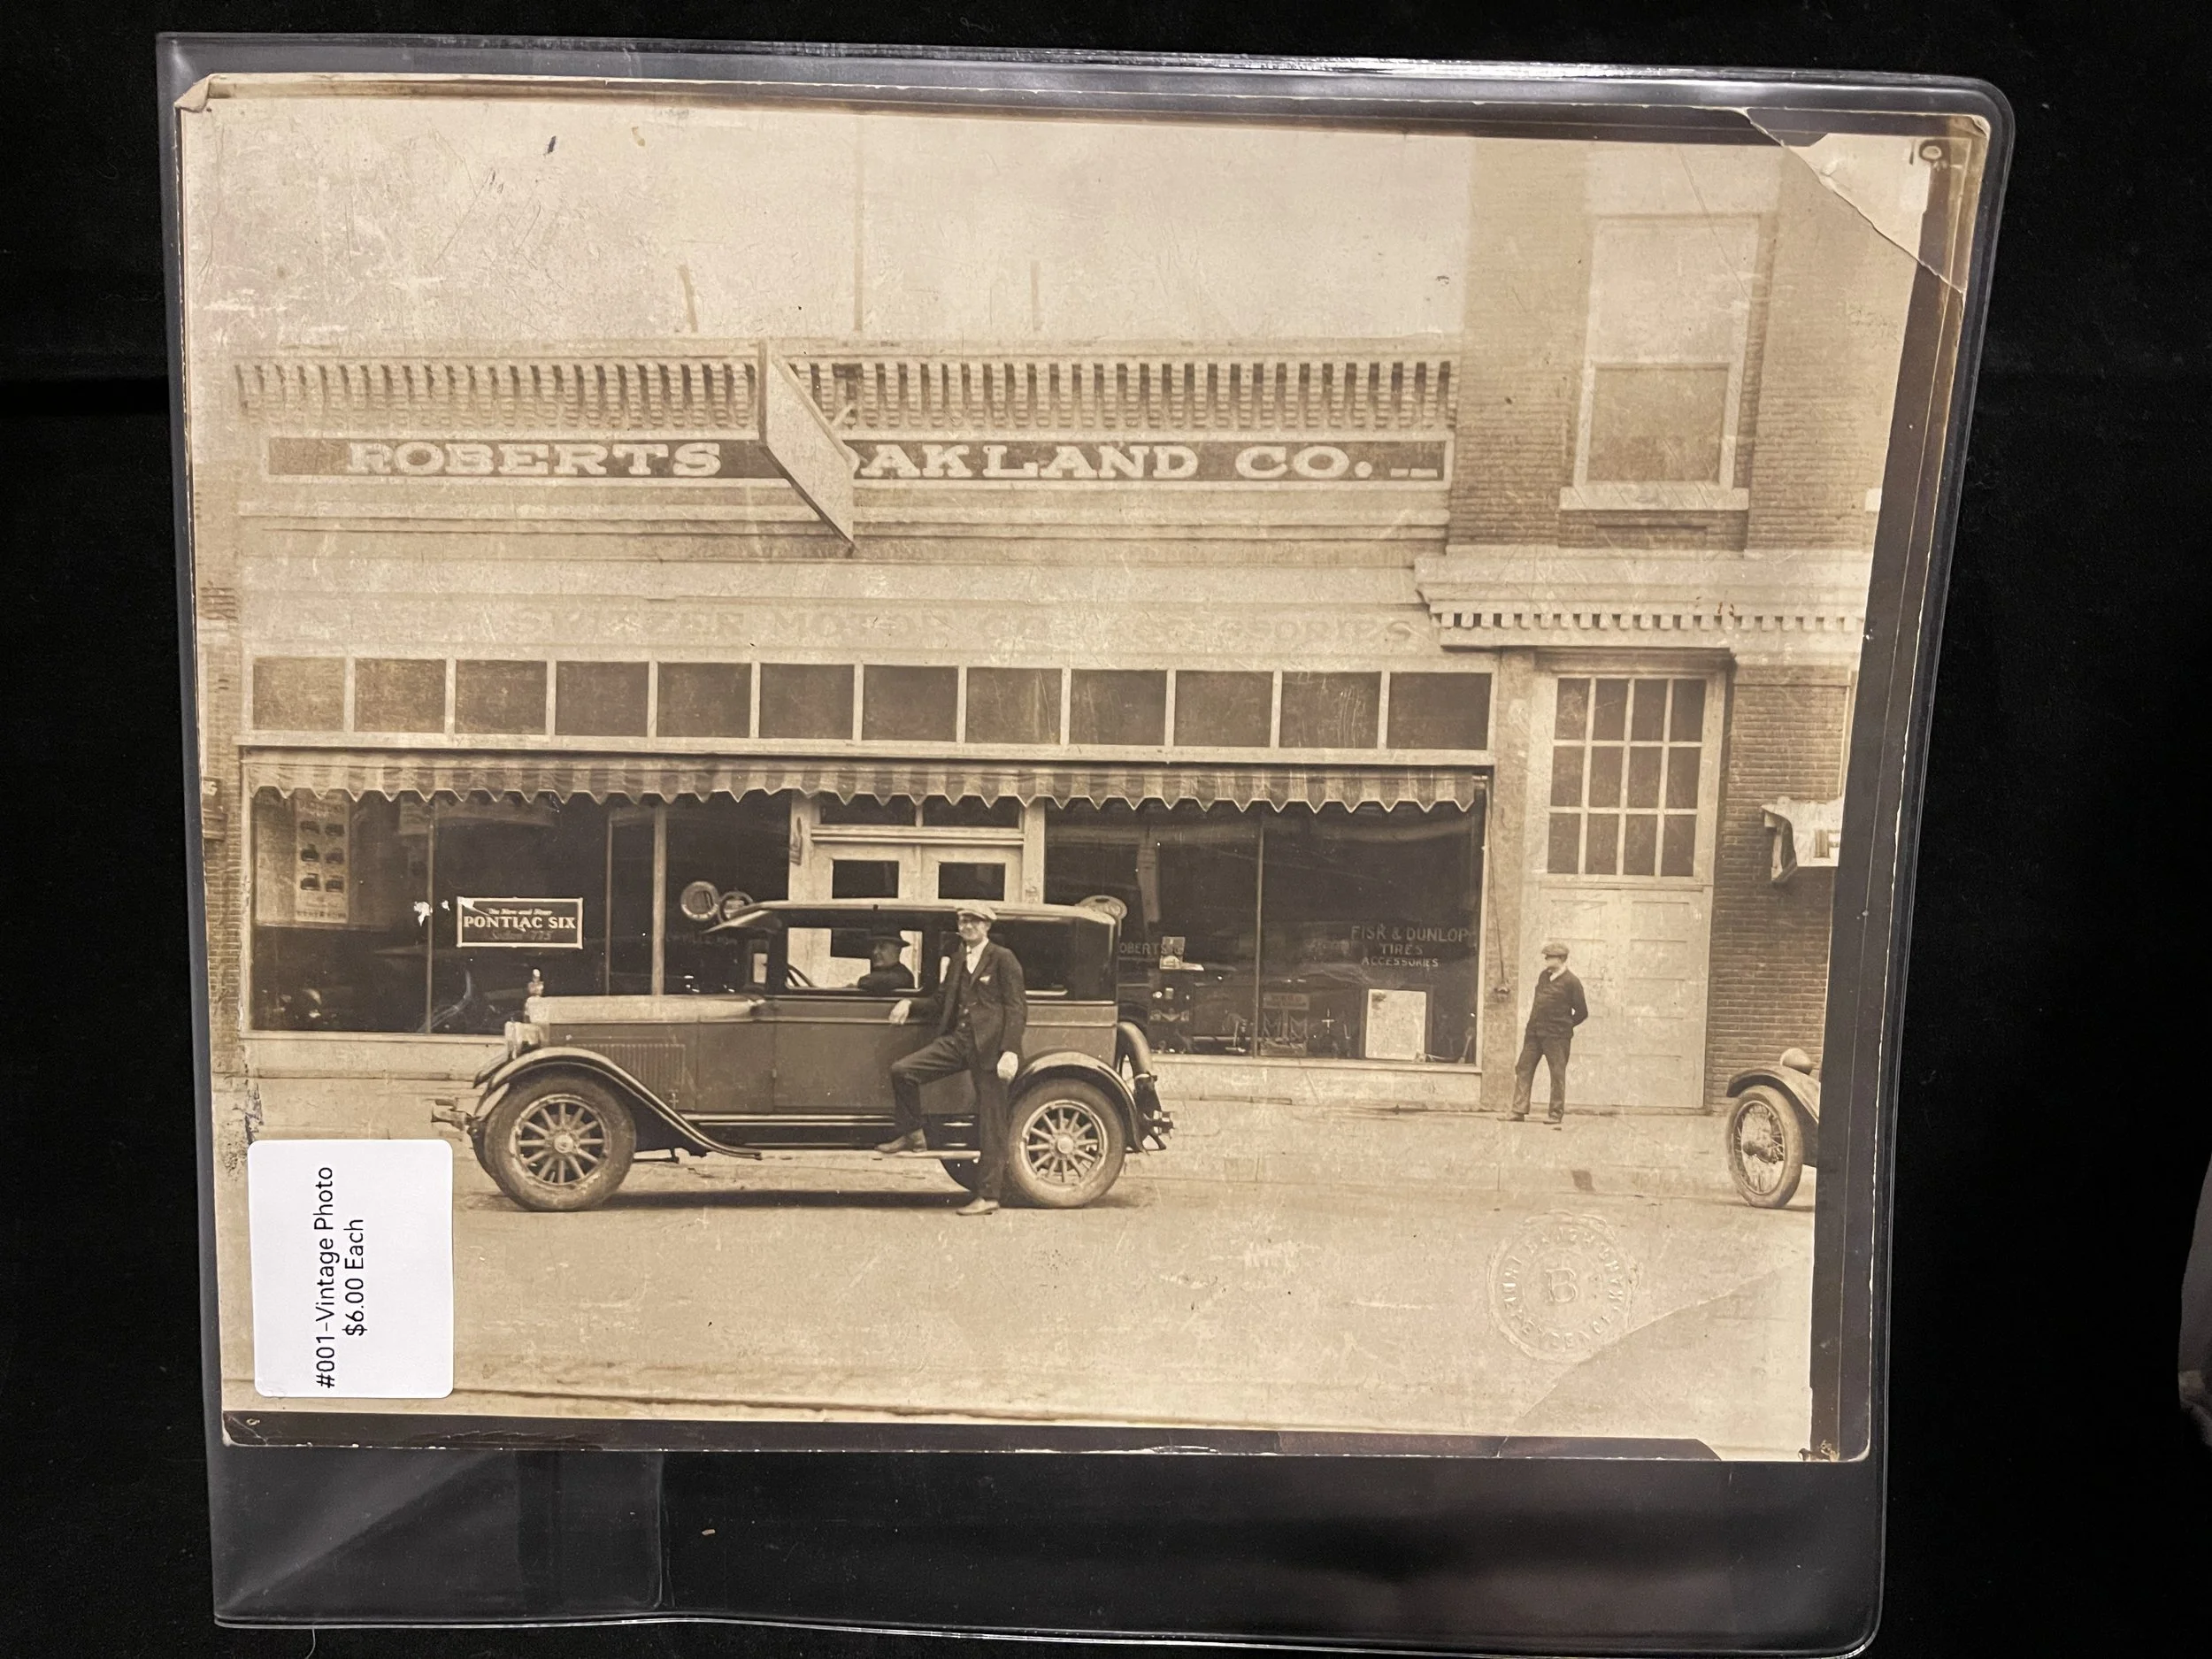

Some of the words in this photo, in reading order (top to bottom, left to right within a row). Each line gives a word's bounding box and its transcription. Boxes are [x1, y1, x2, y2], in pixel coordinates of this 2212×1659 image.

[345, 441, 723, 477] ROBERTS
[847, 443, 1199, 480] AKLAND
[1235, 444, 1373, 480] CO.
[463, 916, 543, 929] PONTIAC
[548, 917, 576, 929] SIX
[1350, 925, 1386, 941] FISK
[1391, 926, 1402, 941] &
[1406, 926, 1468, 942] DUNLOP
[1361, 956, 1440, 969] ACCESSORIES
[1379, 942, 1424, 956] TIRES
[313, 1166, 334, 1231] Photo
[343, 1218, 365, 1271] Each
[313, 1237, 341, 1389] #001-Vintage
[342, 1278, 368, 1337] $6.00
